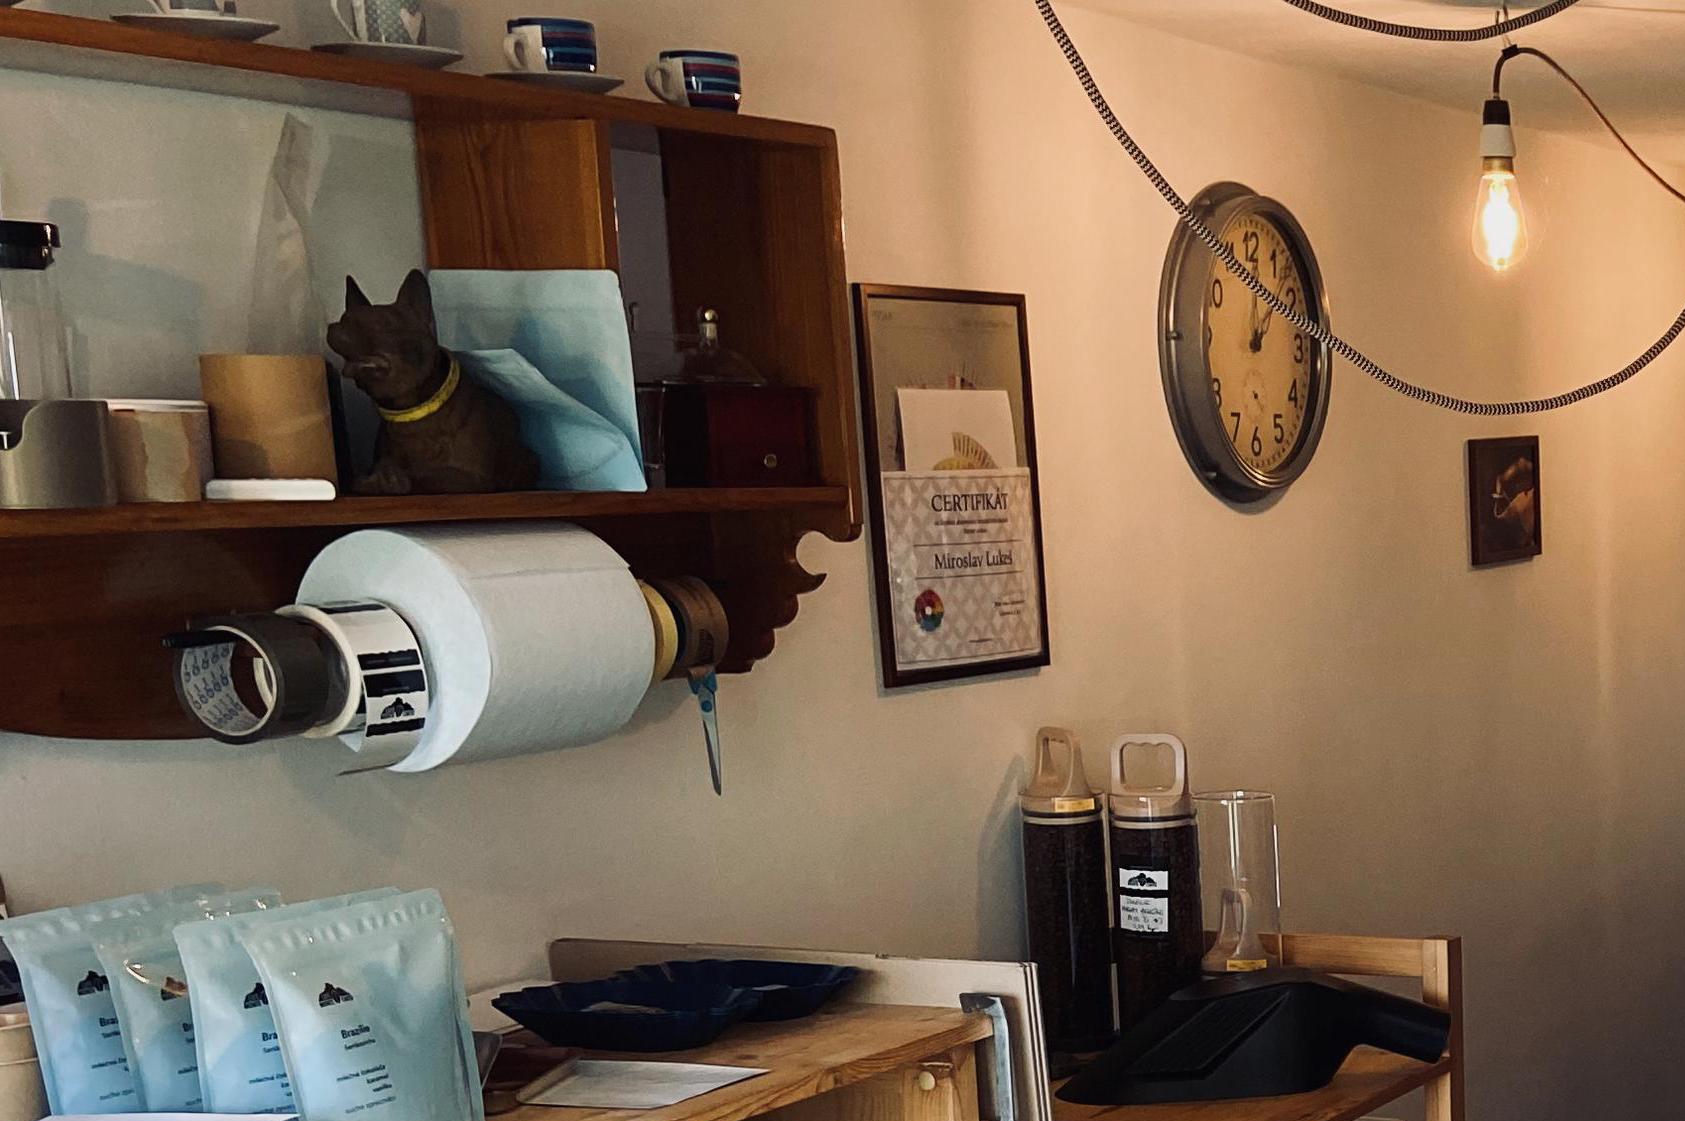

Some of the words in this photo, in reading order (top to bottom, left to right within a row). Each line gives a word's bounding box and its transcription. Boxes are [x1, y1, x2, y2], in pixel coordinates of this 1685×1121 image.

[1242, 231, 1259, 263] 12
[1209, 278, 1223, 309] 0
[1293, 333, 1304, 364] 3
[1288, 378, 1298, 409] 4
[1230, 412, 1241, 442] 7
[1251, 426, 1262, 457] 6
[1273, 413, 1285, 444] 5
[931, 487, 1008, 512] CERTIFIKÁT
[934, 552, 983, 570] Miroslav
